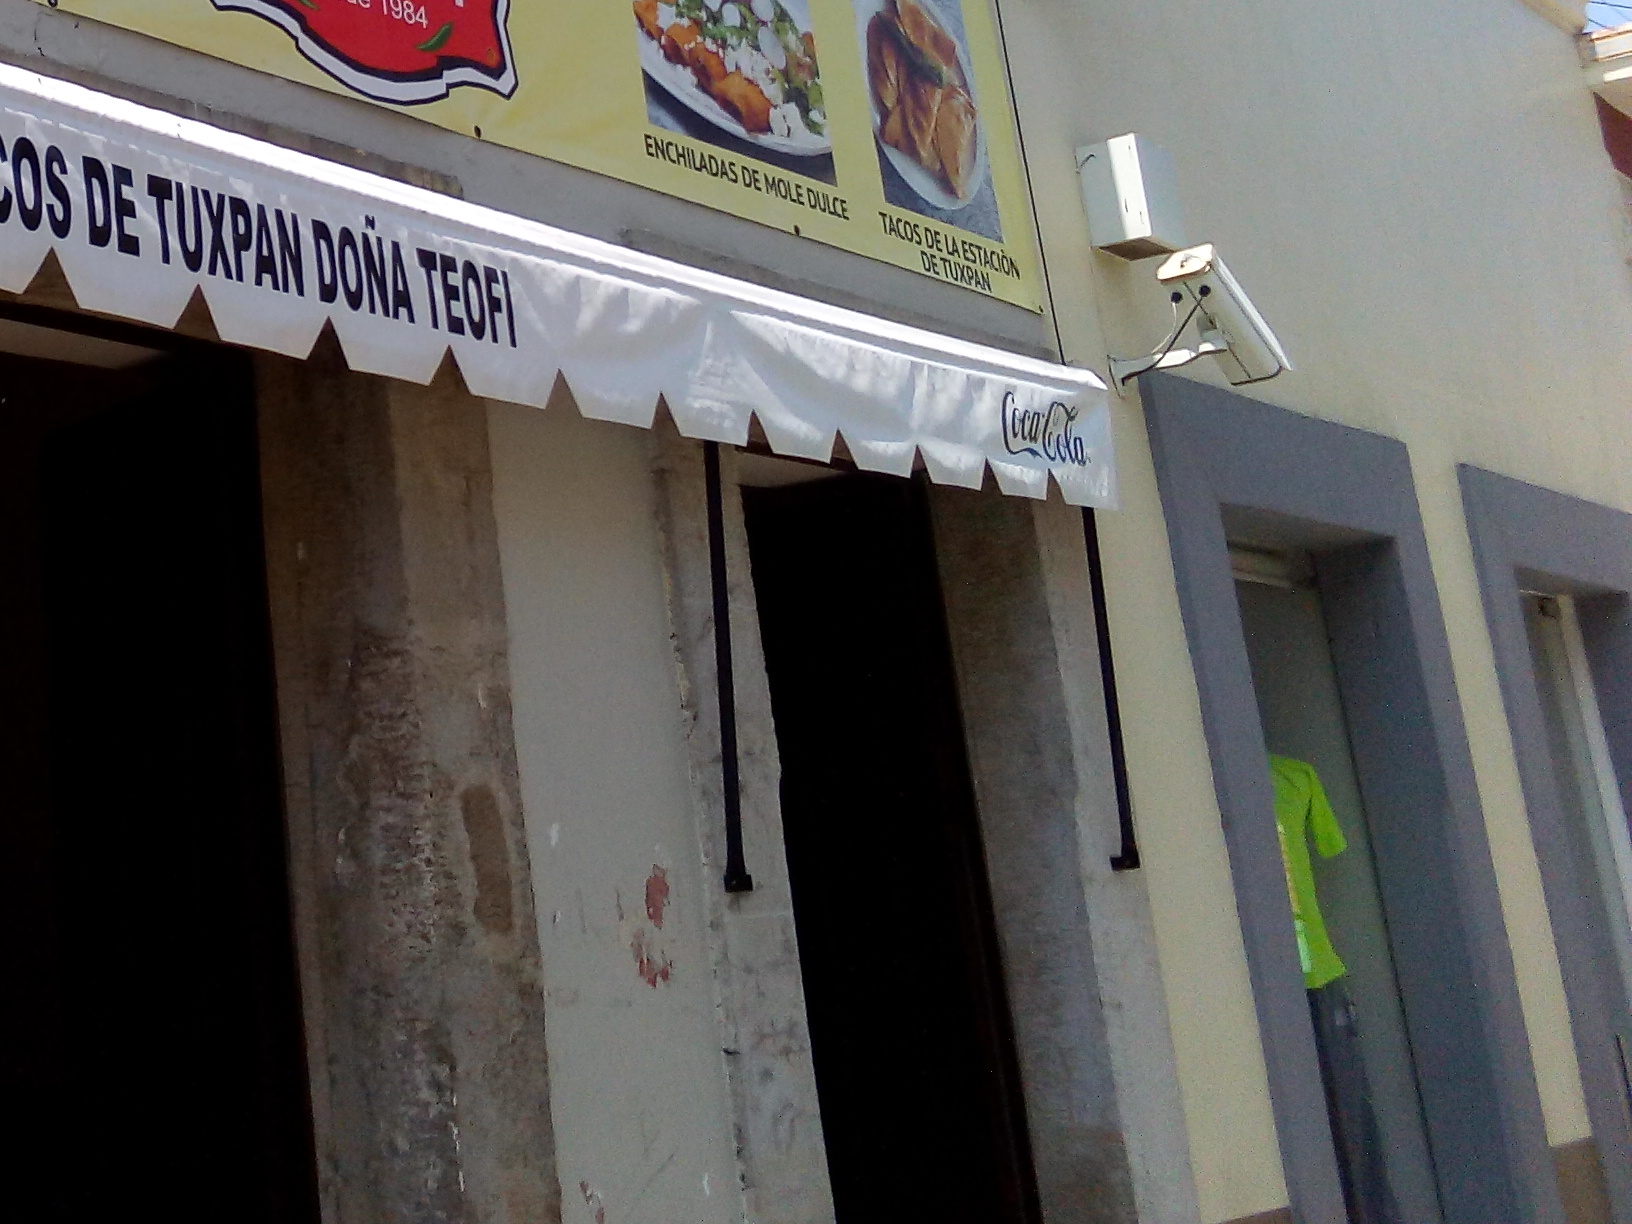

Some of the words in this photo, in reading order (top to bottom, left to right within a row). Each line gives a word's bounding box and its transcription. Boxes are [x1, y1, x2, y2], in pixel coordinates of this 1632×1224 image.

[644, 133, 738, 184] ENCHILADAS
[741, 165, 762, 192] DE
[764, 173, 805, 207] MOLE
[806, 187, 850, 221] DULCE
[80, 156, 141, 258] DE
[146, 172, 305, 298] TUXPAN
[311, 214, 417, 325] DOÑA
[417, 247, 518, 349] TEOFI
[878, 211, 922, 246] TACOS
[924, 227, 943, 253] DE
[944, 233, 961, 259] LA
[920, 250, 940, 276] DE
[939, 257, 993, 294] TUXPAN
